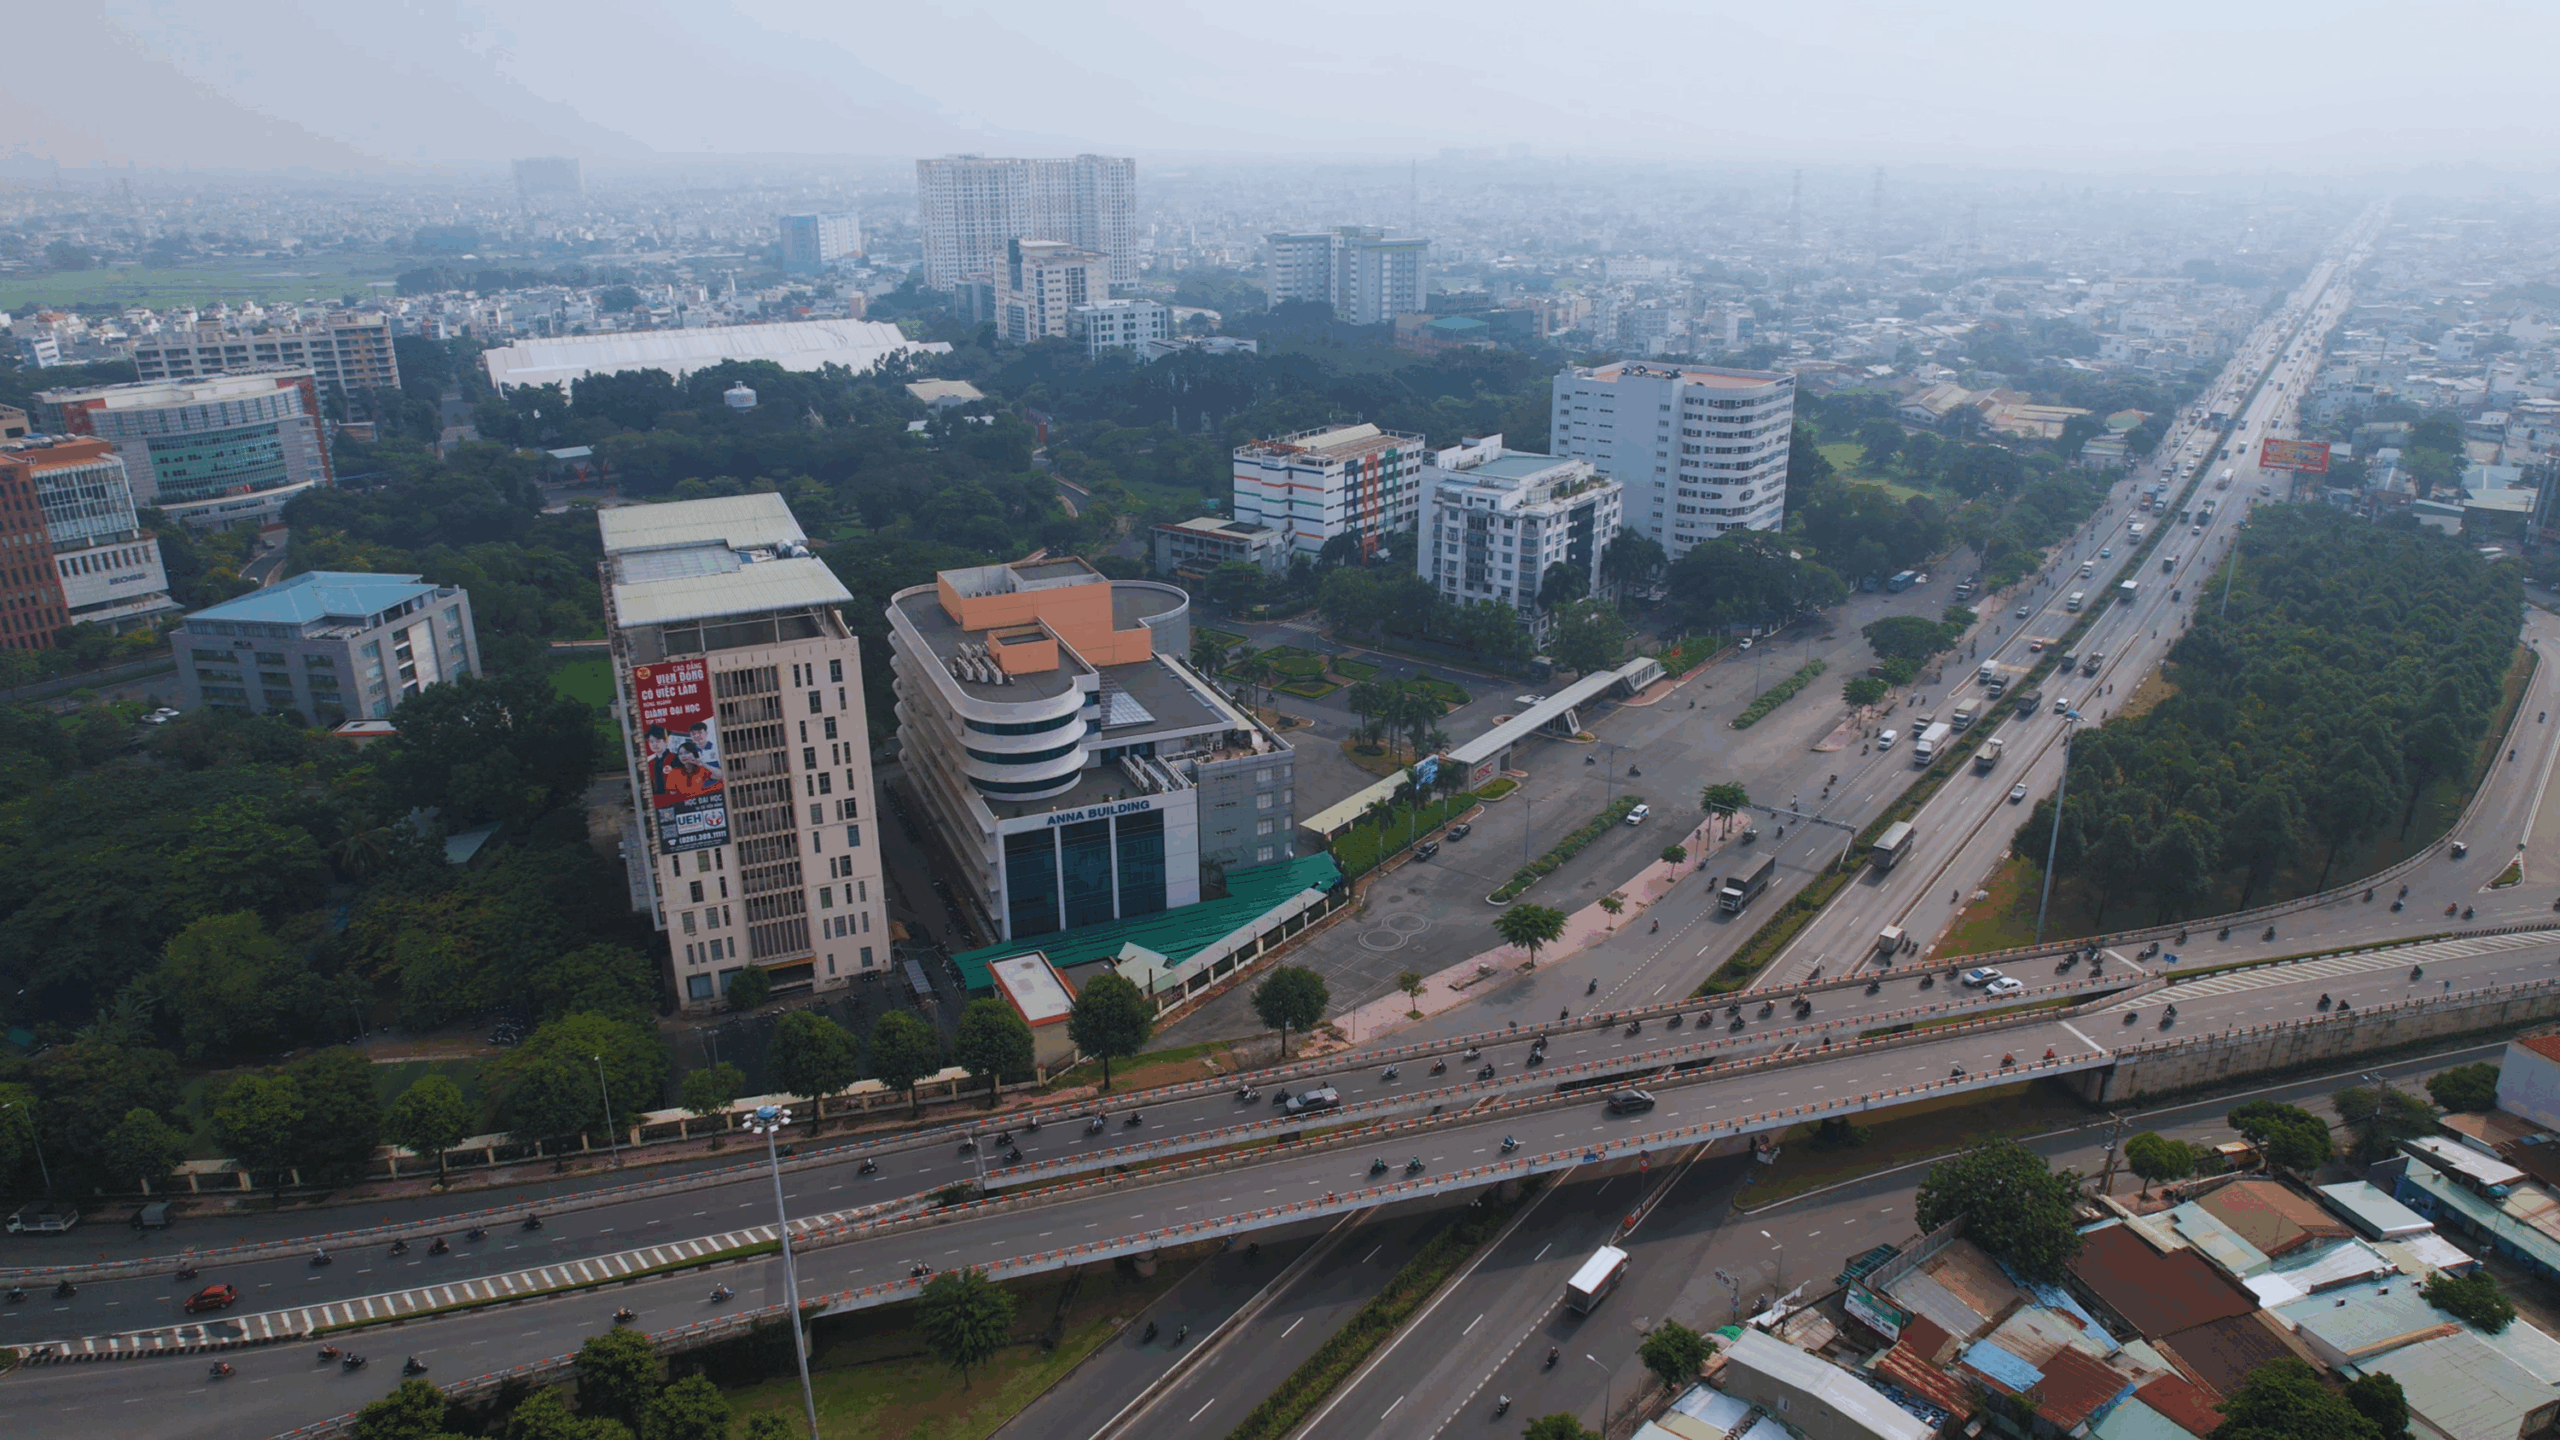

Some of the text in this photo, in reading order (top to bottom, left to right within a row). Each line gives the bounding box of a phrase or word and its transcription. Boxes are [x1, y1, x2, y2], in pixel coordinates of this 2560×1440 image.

[678, 814, 701, 825] UEH
[1047, 800, 1149, 825] ANNA BUILDING
